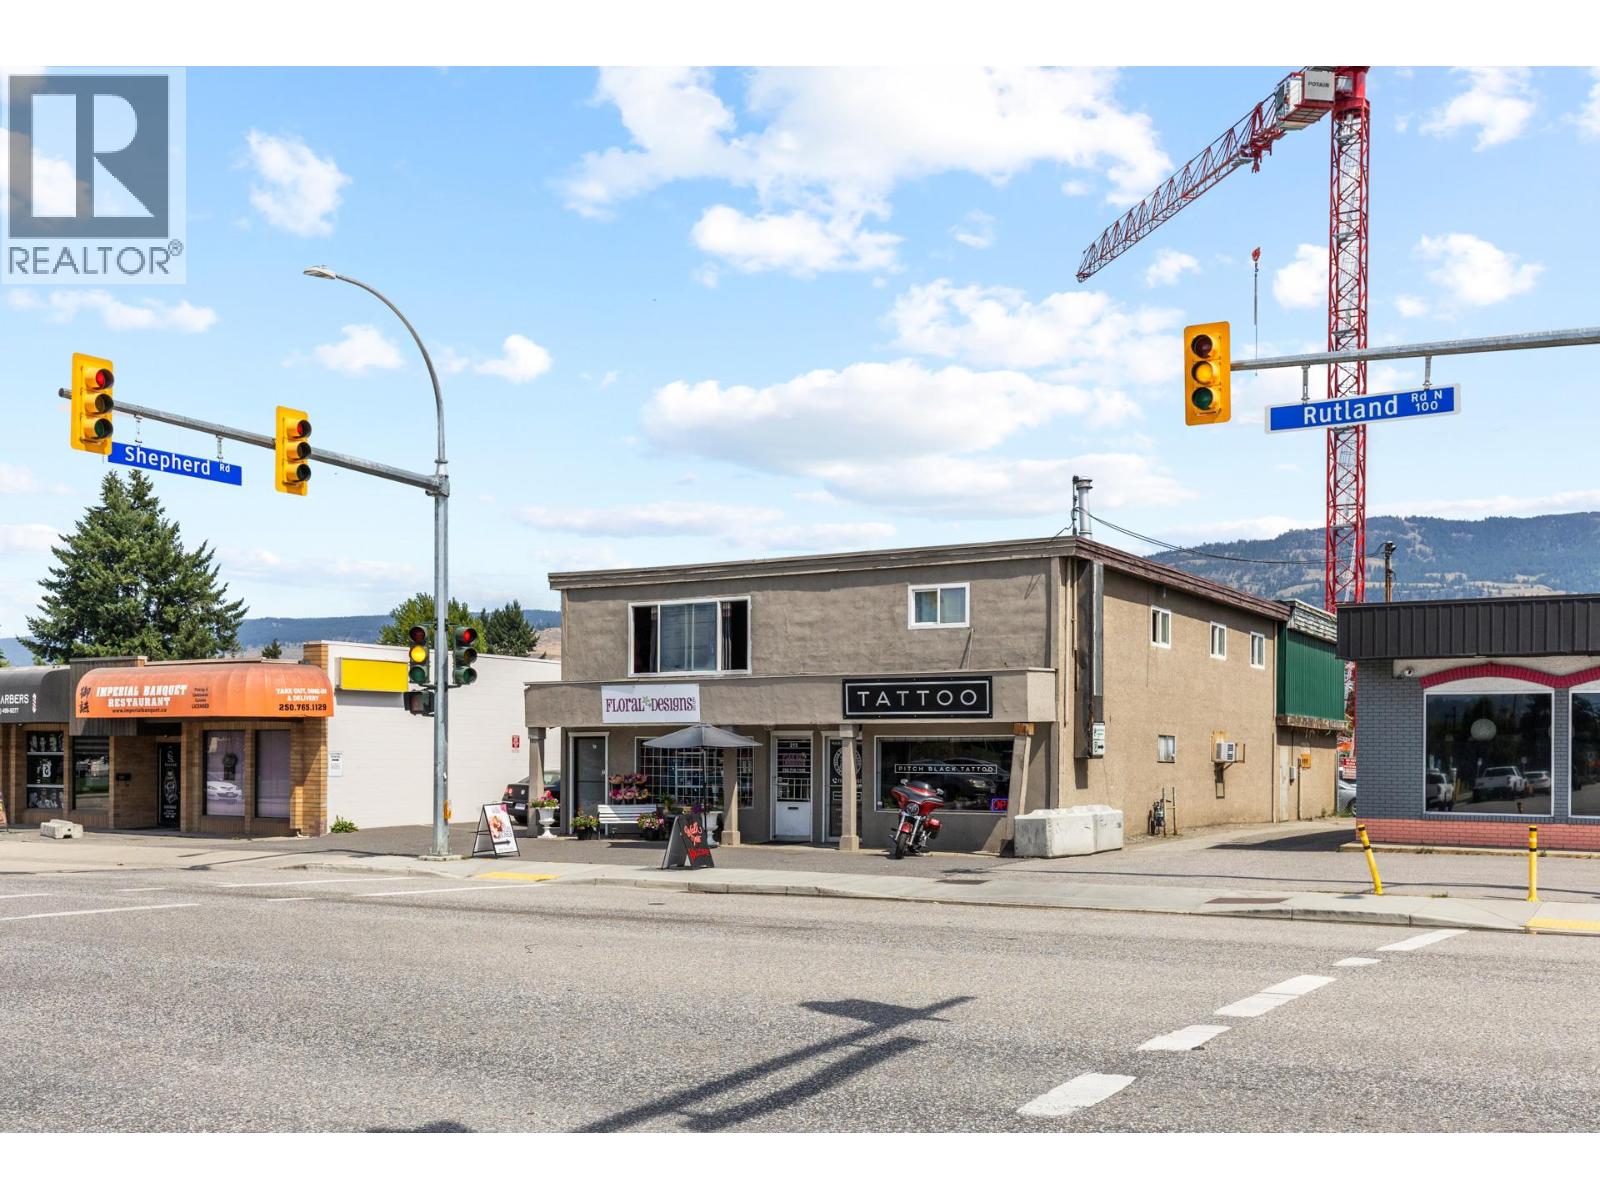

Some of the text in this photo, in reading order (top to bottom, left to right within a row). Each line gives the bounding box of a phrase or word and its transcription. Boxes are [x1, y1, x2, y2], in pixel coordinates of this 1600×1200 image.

[1303, 389, 1444, 425] Rutland Rd N
[1414, 400, 1439, 412] 100
[124, 446, 231, 476] Shepherd Rd
[96, 686, 139, 697] IMPERIAL
[143, 684, 188, 697] BANQUET
[857, 689, 977, 707] TATTOO
[107, 697, 171, 708] RESTAURANT
